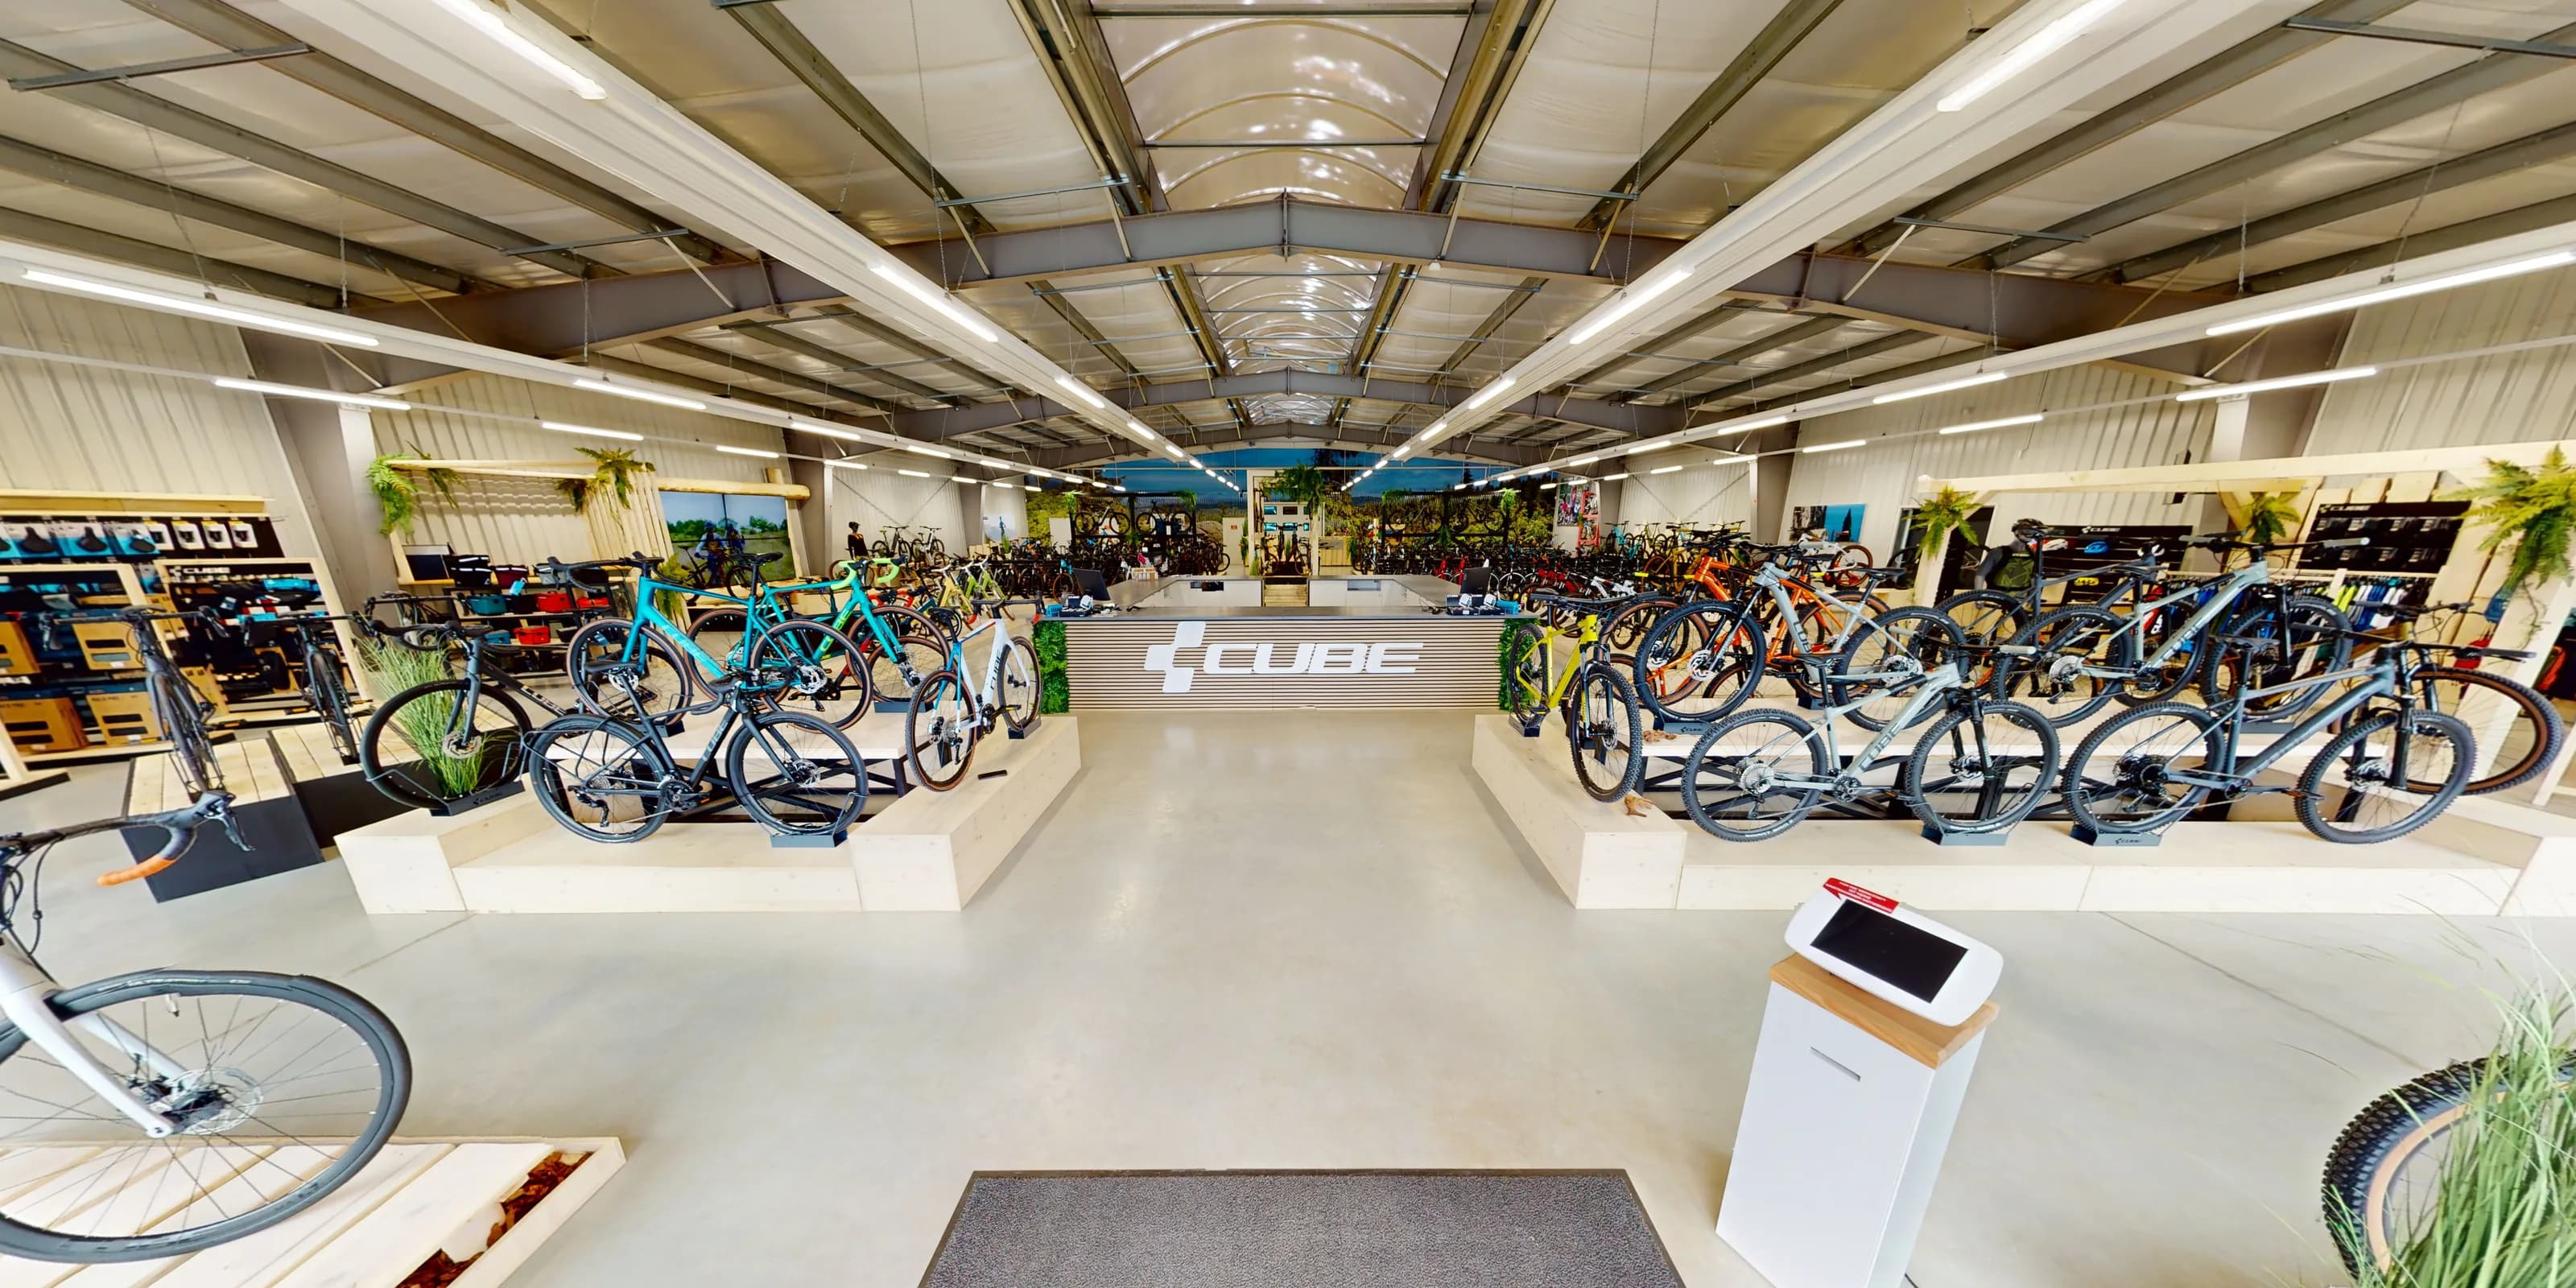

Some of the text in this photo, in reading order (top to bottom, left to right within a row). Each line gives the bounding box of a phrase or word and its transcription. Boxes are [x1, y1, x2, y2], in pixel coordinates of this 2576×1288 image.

[1794, 621, 1810, 653] CUB
[1203, 642, 1424, 675] CUBE
[702, 720, 729, 762] CUBE
[1858, 722, 1901, 772] CUBE
